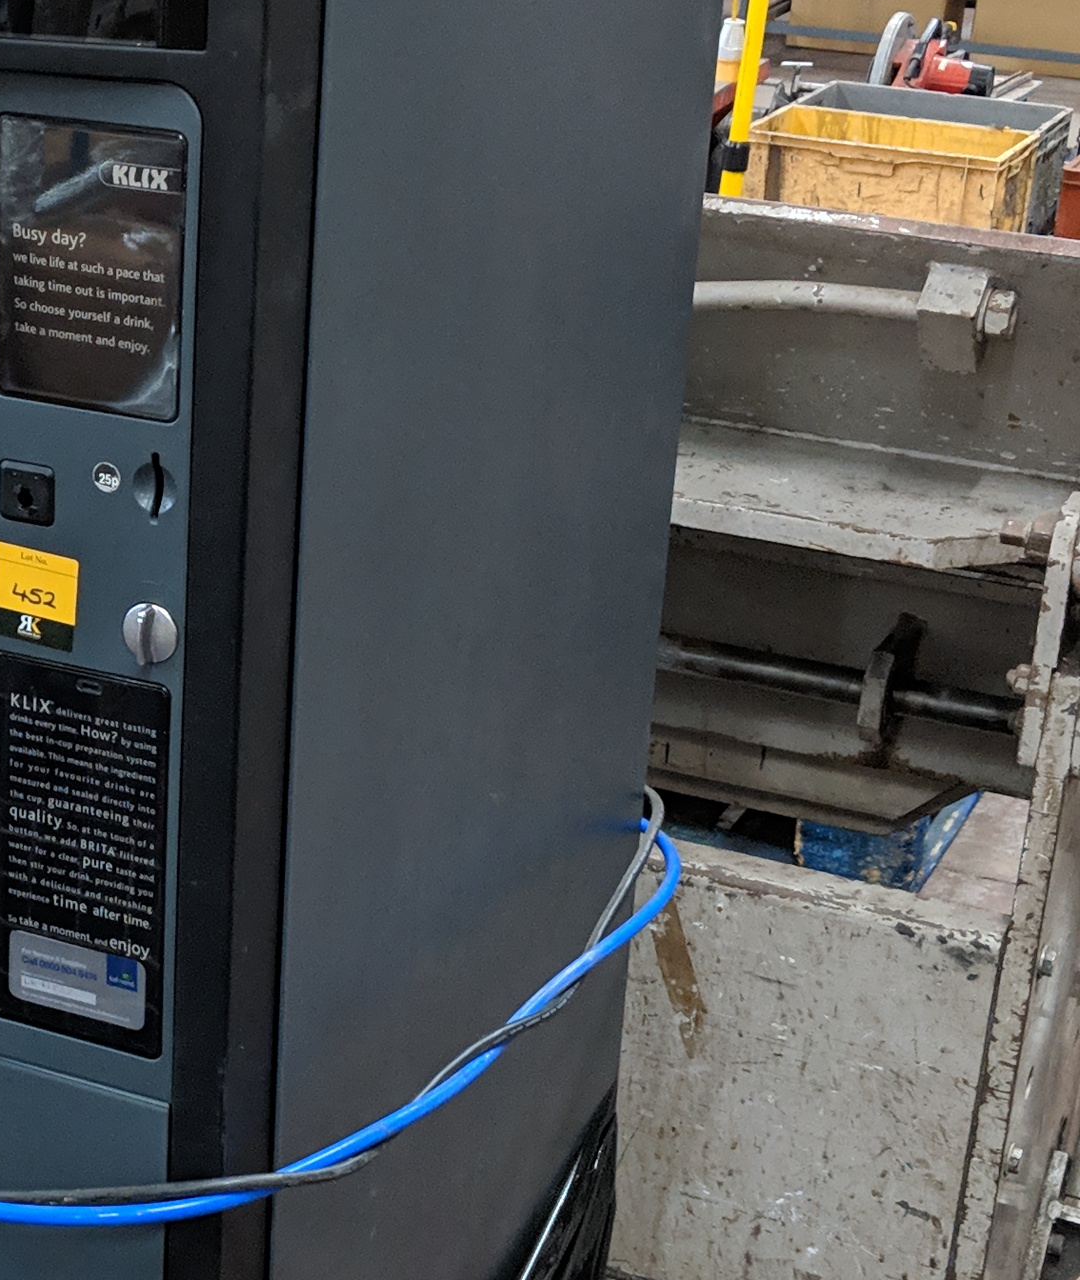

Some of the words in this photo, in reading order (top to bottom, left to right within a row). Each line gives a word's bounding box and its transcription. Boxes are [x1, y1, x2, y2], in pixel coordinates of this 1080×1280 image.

[112, 164, 168, 190] KLIX
[13, 223, 47, 246] Busy
[51, 228, 86, 251] day?
[13, 253, 27, 263] we
[29, 253, 47, 266] live
[49, 256, 65, 269] life
[68, 261, 78, 270] at
[81, 263, 104, 275] such
[107, 267, 113, 276] a
[116, 268, 140, 280] pace
[143, 270, 165, 283] that
[14, 275, 45, 293] taking
[48, 280, 72, 294] time
[75, 285, 93, 297] out
[96, 287, 105, 298] is
[108, 289, 165, 307] important.
[14, 297, 27, 309] So
[29, 301, 65, 316] choose
[68, 308, 112, 323] yourself
[114, 316, 120, 325] a
[123, 315, 153, 331] drink,
[15, 321, 36, 334] take
[39, 327, 45, 335] a
[48, 329, 93, 344] moment
[95, 336, 115, 347] and
[118, 339, 150, 355] enjoy.
[99, 473, 119, 488] 25p
[20, 552, 33, 560] Lot
[12, 583, 56, 609] 452
[10, 692, 51, 714] KLIX
[56, 707, 92, 722] delivers
[94, 717, 119, 728] great
[123, 722, 157, 738] tasting
[9, 728, 23, 738] the
[26, 732, 44, 743] best
[75, 743, 124, 760] preparation
[126, 755, 157, 768] system
[81, 724, 118, 743] How?
[121, 737, 131, 748] by
[134, 741, 157, 755] using
[9, 758, 23, 769] for
[28, 764, 50, 774] your
[54, 768, 101, 786] favourite
[104, 780, 135, 795] drinks
[140, 790, 156, 800] are
[48, 751, 65, 763] This
[67, 757, 93, 769] means
[95, 763, 109, 773] the
[111, 765, 156, 784] ingredients
[9, 774, 51, 790] measured
[53, 784, 69, 795] and
[71, 789, 99, 802] sealed
[101, 795, 135, 812] directly
[138, 803, 156, 815] into
[47, 797, 130, 827] guaranteeing
[133, 818, 155, 829] their
[82, 825, 91, 834] at
[93, 828, 107, 838] the
[110, 833, 135, 845] touch
[8, 840, 32, 851] water
[35, 846, 47, 856] for
[82, 856, 113, 872] pure
[116, 867, 137, 878] taste
[139, 873, 155, 883] and
[60, 837, 77, 848] add
[80, 838, 115, 857] BRITA
[120, 850, 155, 867] filtered
[8, 871, 28, 882] with
[40, 878, 81, 895] delicious
[85, 890, 101, 900] and
[104, 895, 153, 915] refreshing
[47, 864, 66, 875] your
[95, 877, 135, 895] providing
[137, 888, 154, 898] you
[53, 894, 87, 913] time
[93, 905, 121, 921] after
[123, 913, 152, 930] time.
[19, 916, 39, 929] take
[42, 923, 47, 931] a
[50, 925, 93, 944] moment,
[94, 937, 108, 947] and
